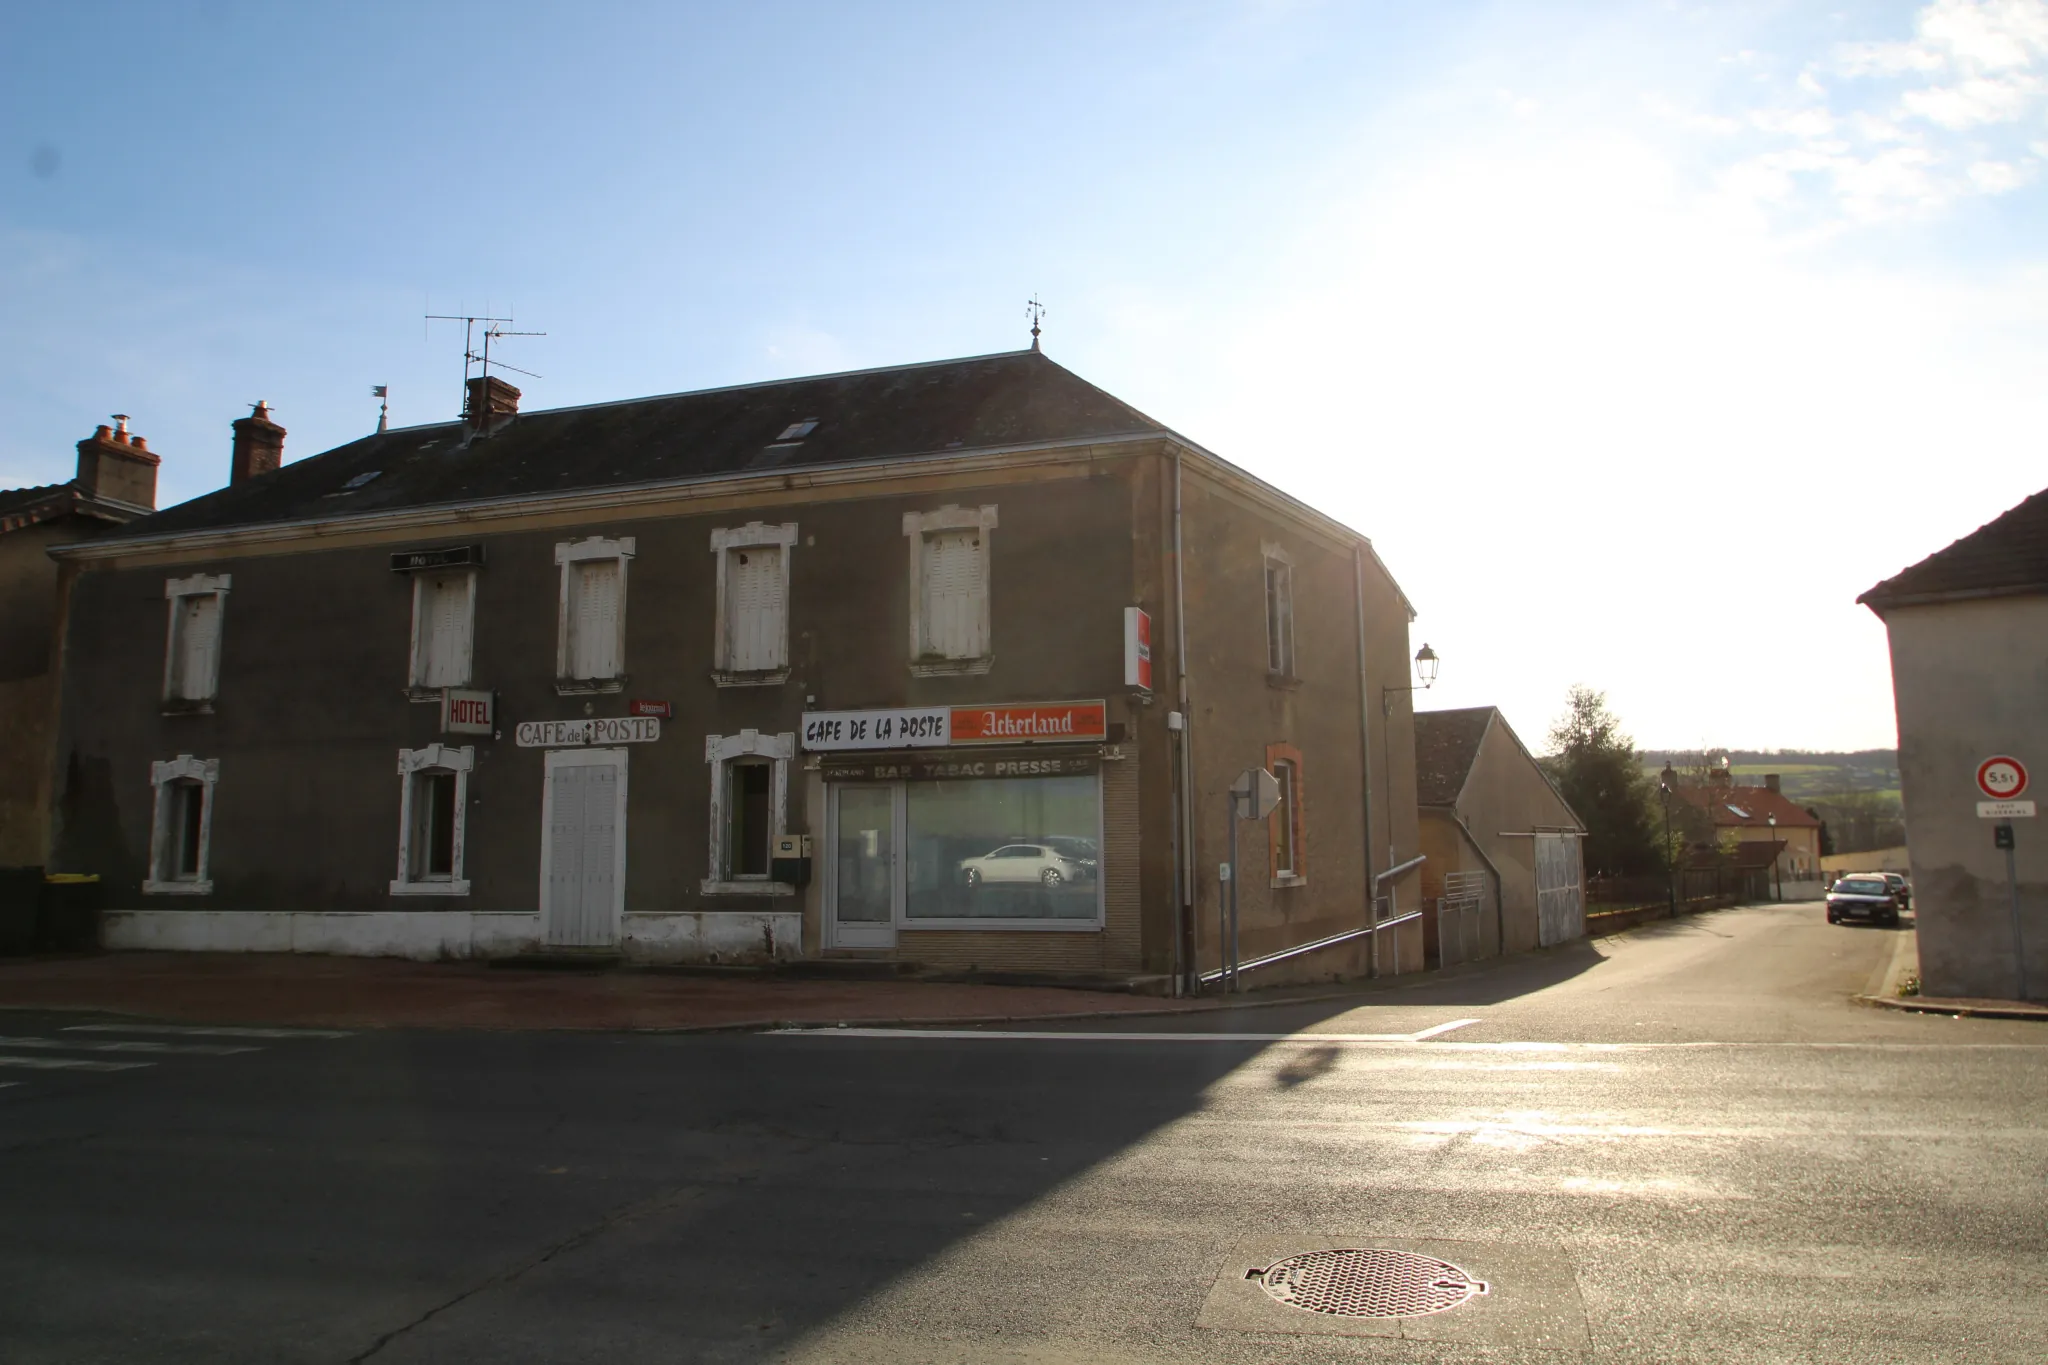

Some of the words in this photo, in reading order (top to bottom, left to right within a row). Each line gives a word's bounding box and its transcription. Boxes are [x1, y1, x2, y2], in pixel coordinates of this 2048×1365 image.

[450, 699, 490, 725] HOTEL
[980, 709, 1074, 737] Ackerland
[519, 722, 566, 744] CAFE
[567, 730, 580, 742] de
[593, 719, 657, 741] POSTE
[806, 720, 842, 743] CAFE
[850, 719, 867, 741] DE
[875, 717, 892, 741] LA
[899, 716, 944, 739] POSTE
[874, 764, 912, 779] BAR
[923, 762, 985, 777] TABAC
[995, 760, 1061, 775] PRESSE
